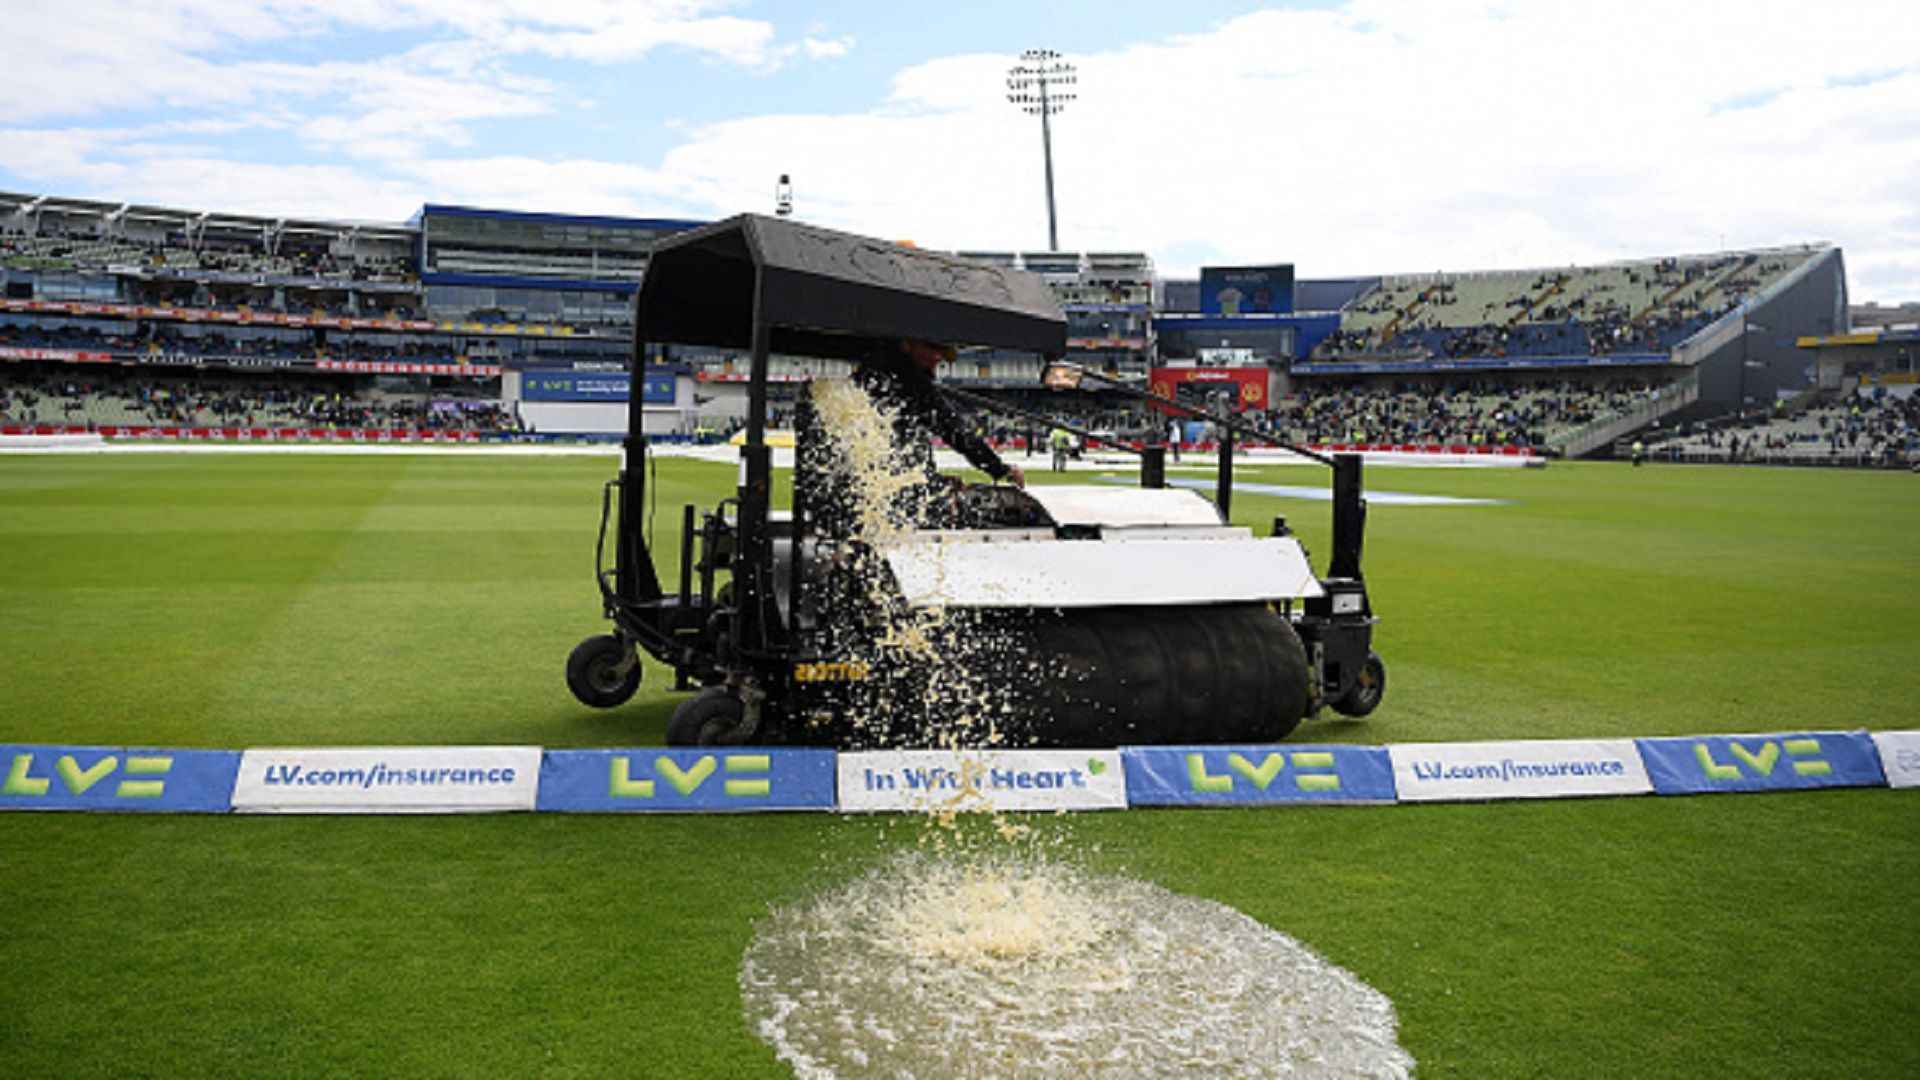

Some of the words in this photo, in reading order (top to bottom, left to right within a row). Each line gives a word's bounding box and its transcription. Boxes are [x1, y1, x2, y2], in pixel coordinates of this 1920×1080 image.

[263, 764, 516, 788] LV.com/insurance
[864, 768, 894, 790] In
[991, 768, 1086, 789] Heart
[1412, 759, 1624, 781] LV.com/insurance
